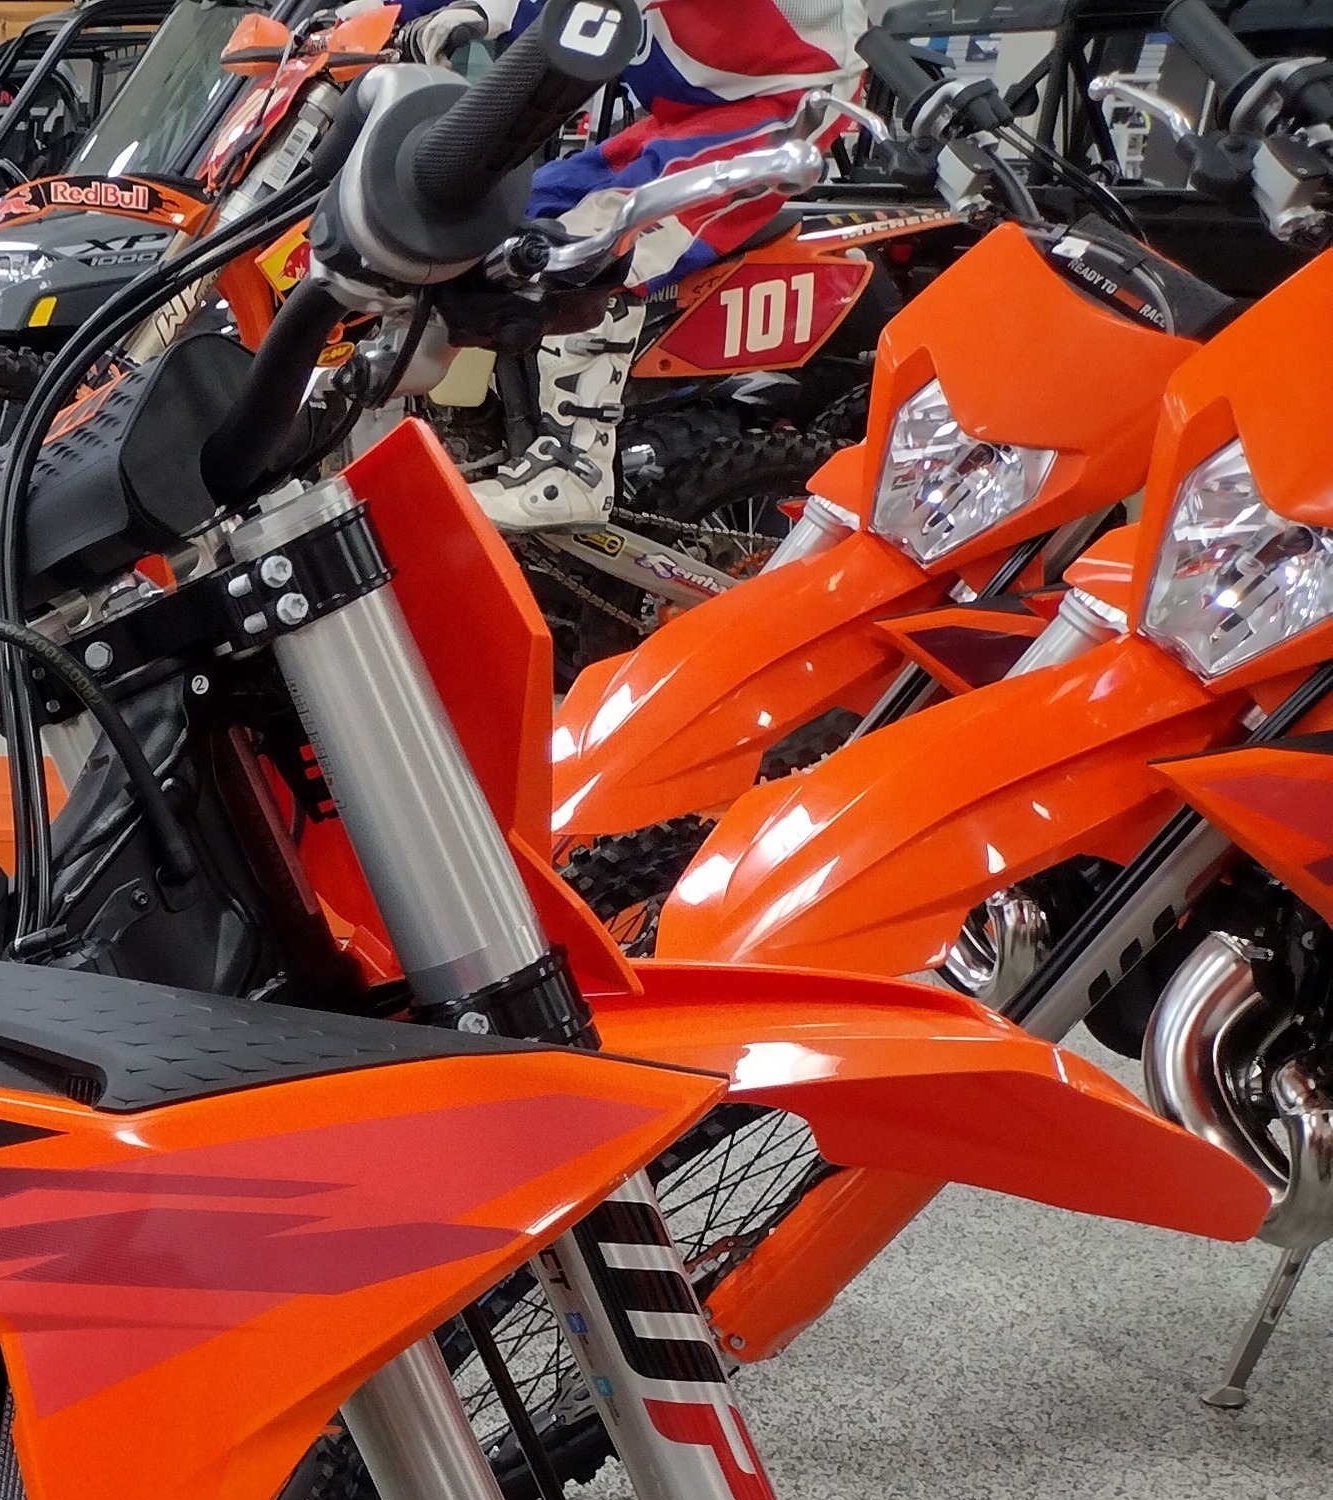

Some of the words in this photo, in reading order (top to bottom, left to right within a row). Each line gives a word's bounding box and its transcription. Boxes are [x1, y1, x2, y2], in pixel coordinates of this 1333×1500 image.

[50, 181, 101, 205] Red
[101, 182, 149, 210] Bull
[73, 232, 169, 254] XP
[90, 251, 159, 267] 1000
[1067, 258, 1105, 286] READY
[1100, 278, 1119, 296] TO
[719, 271, 817, 360] 101
[536, 1245, 574, 1292] CT
